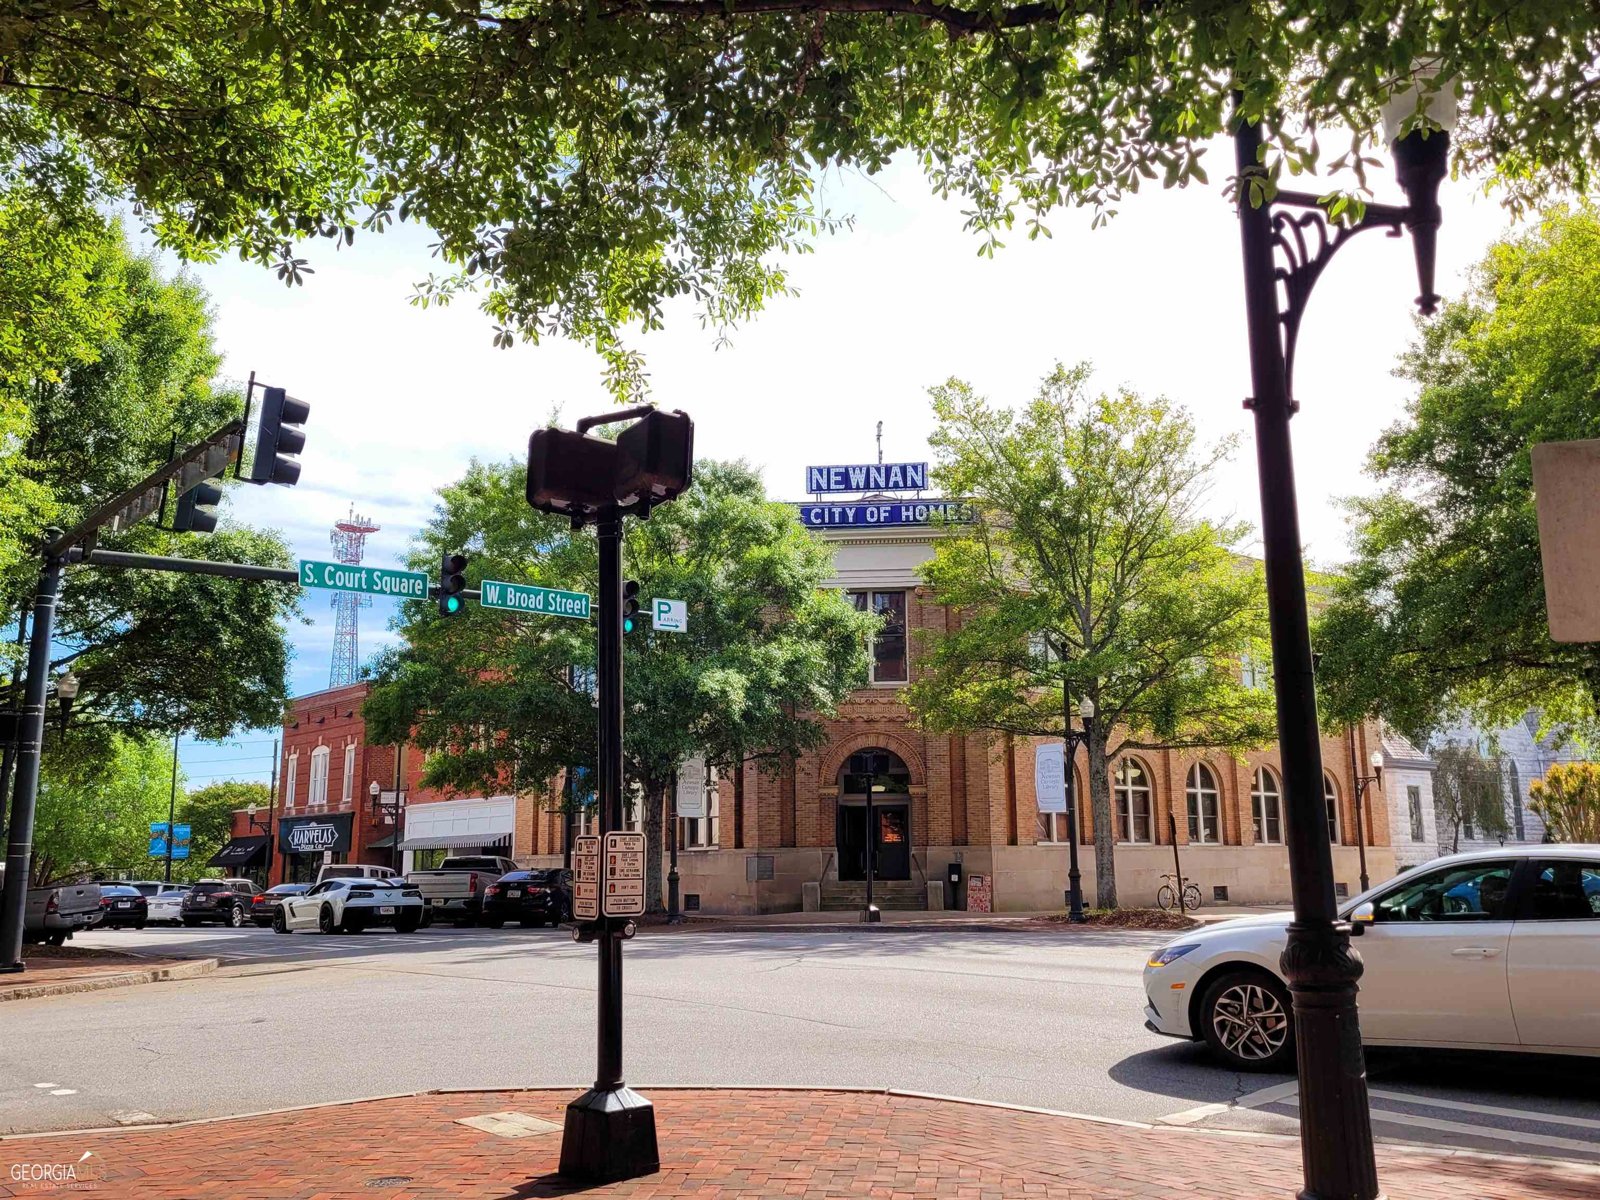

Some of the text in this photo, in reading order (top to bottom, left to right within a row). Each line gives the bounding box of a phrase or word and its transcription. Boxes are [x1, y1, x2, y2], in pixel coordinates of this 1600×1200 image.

[811, 465, 923, 490] NEWNAN
[810, 507, 857, 524] CITY
[866, 506, 892, 523] OF
[304, 563, 424, 595] S. Court Square
[486, 584, 587, 615] W. Broad Street
[294, 829, 332, 845] KARVELAS
